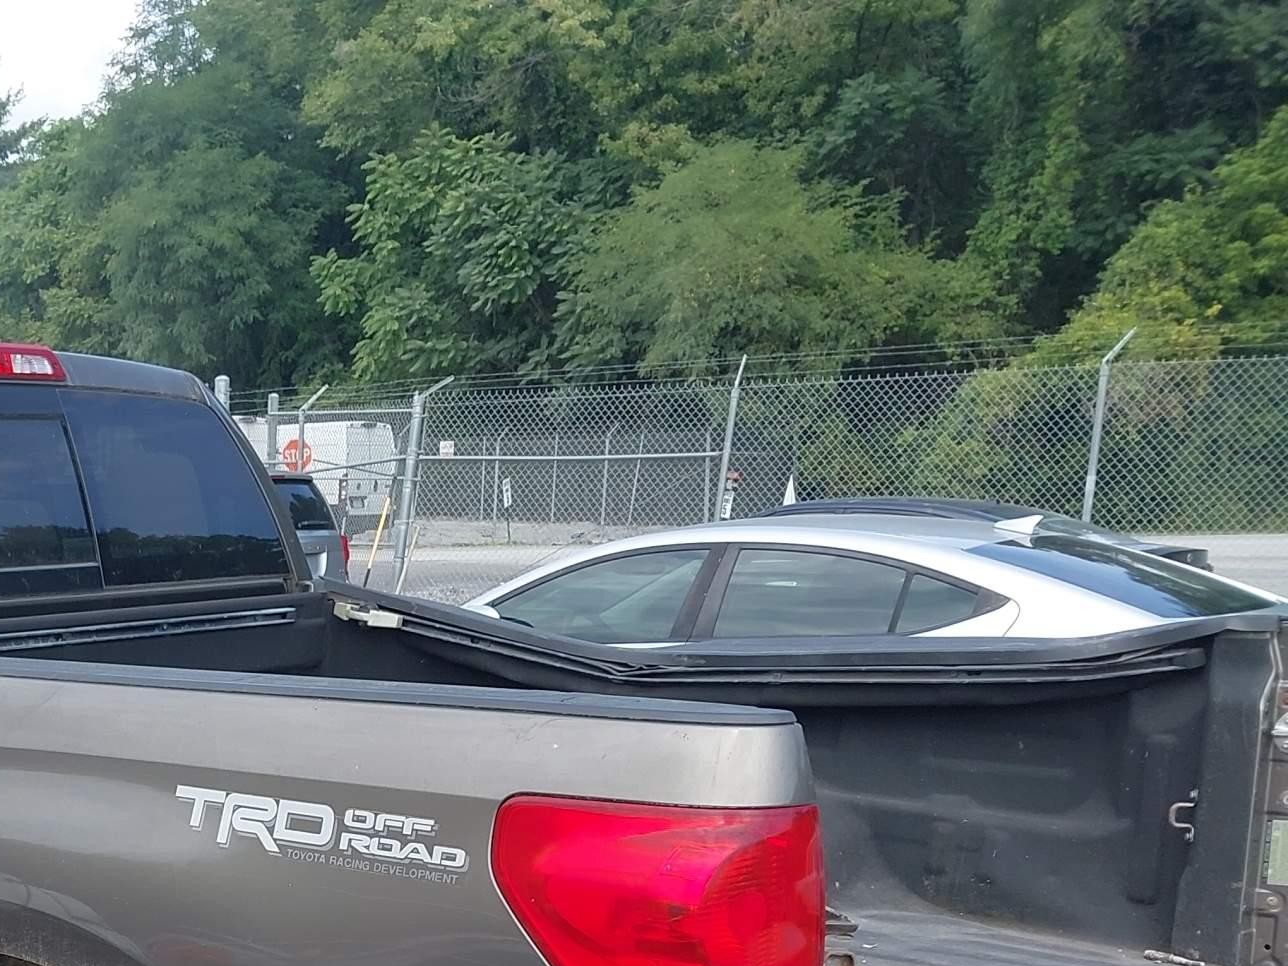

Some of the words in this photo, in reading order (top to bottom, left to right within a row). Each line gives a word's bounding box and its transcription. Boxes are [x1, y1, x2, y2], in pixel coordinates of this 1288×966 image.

[175, 784, 338, 856] TRD
[343, 808, 439, 839] OFF
[287, 848, 326, 864] TOYOTA
[329, 855, 370, 872] RACING
[373, 863, 459, 885] DEVELOPMENT
[338, 832, 470, 872] ROAD
